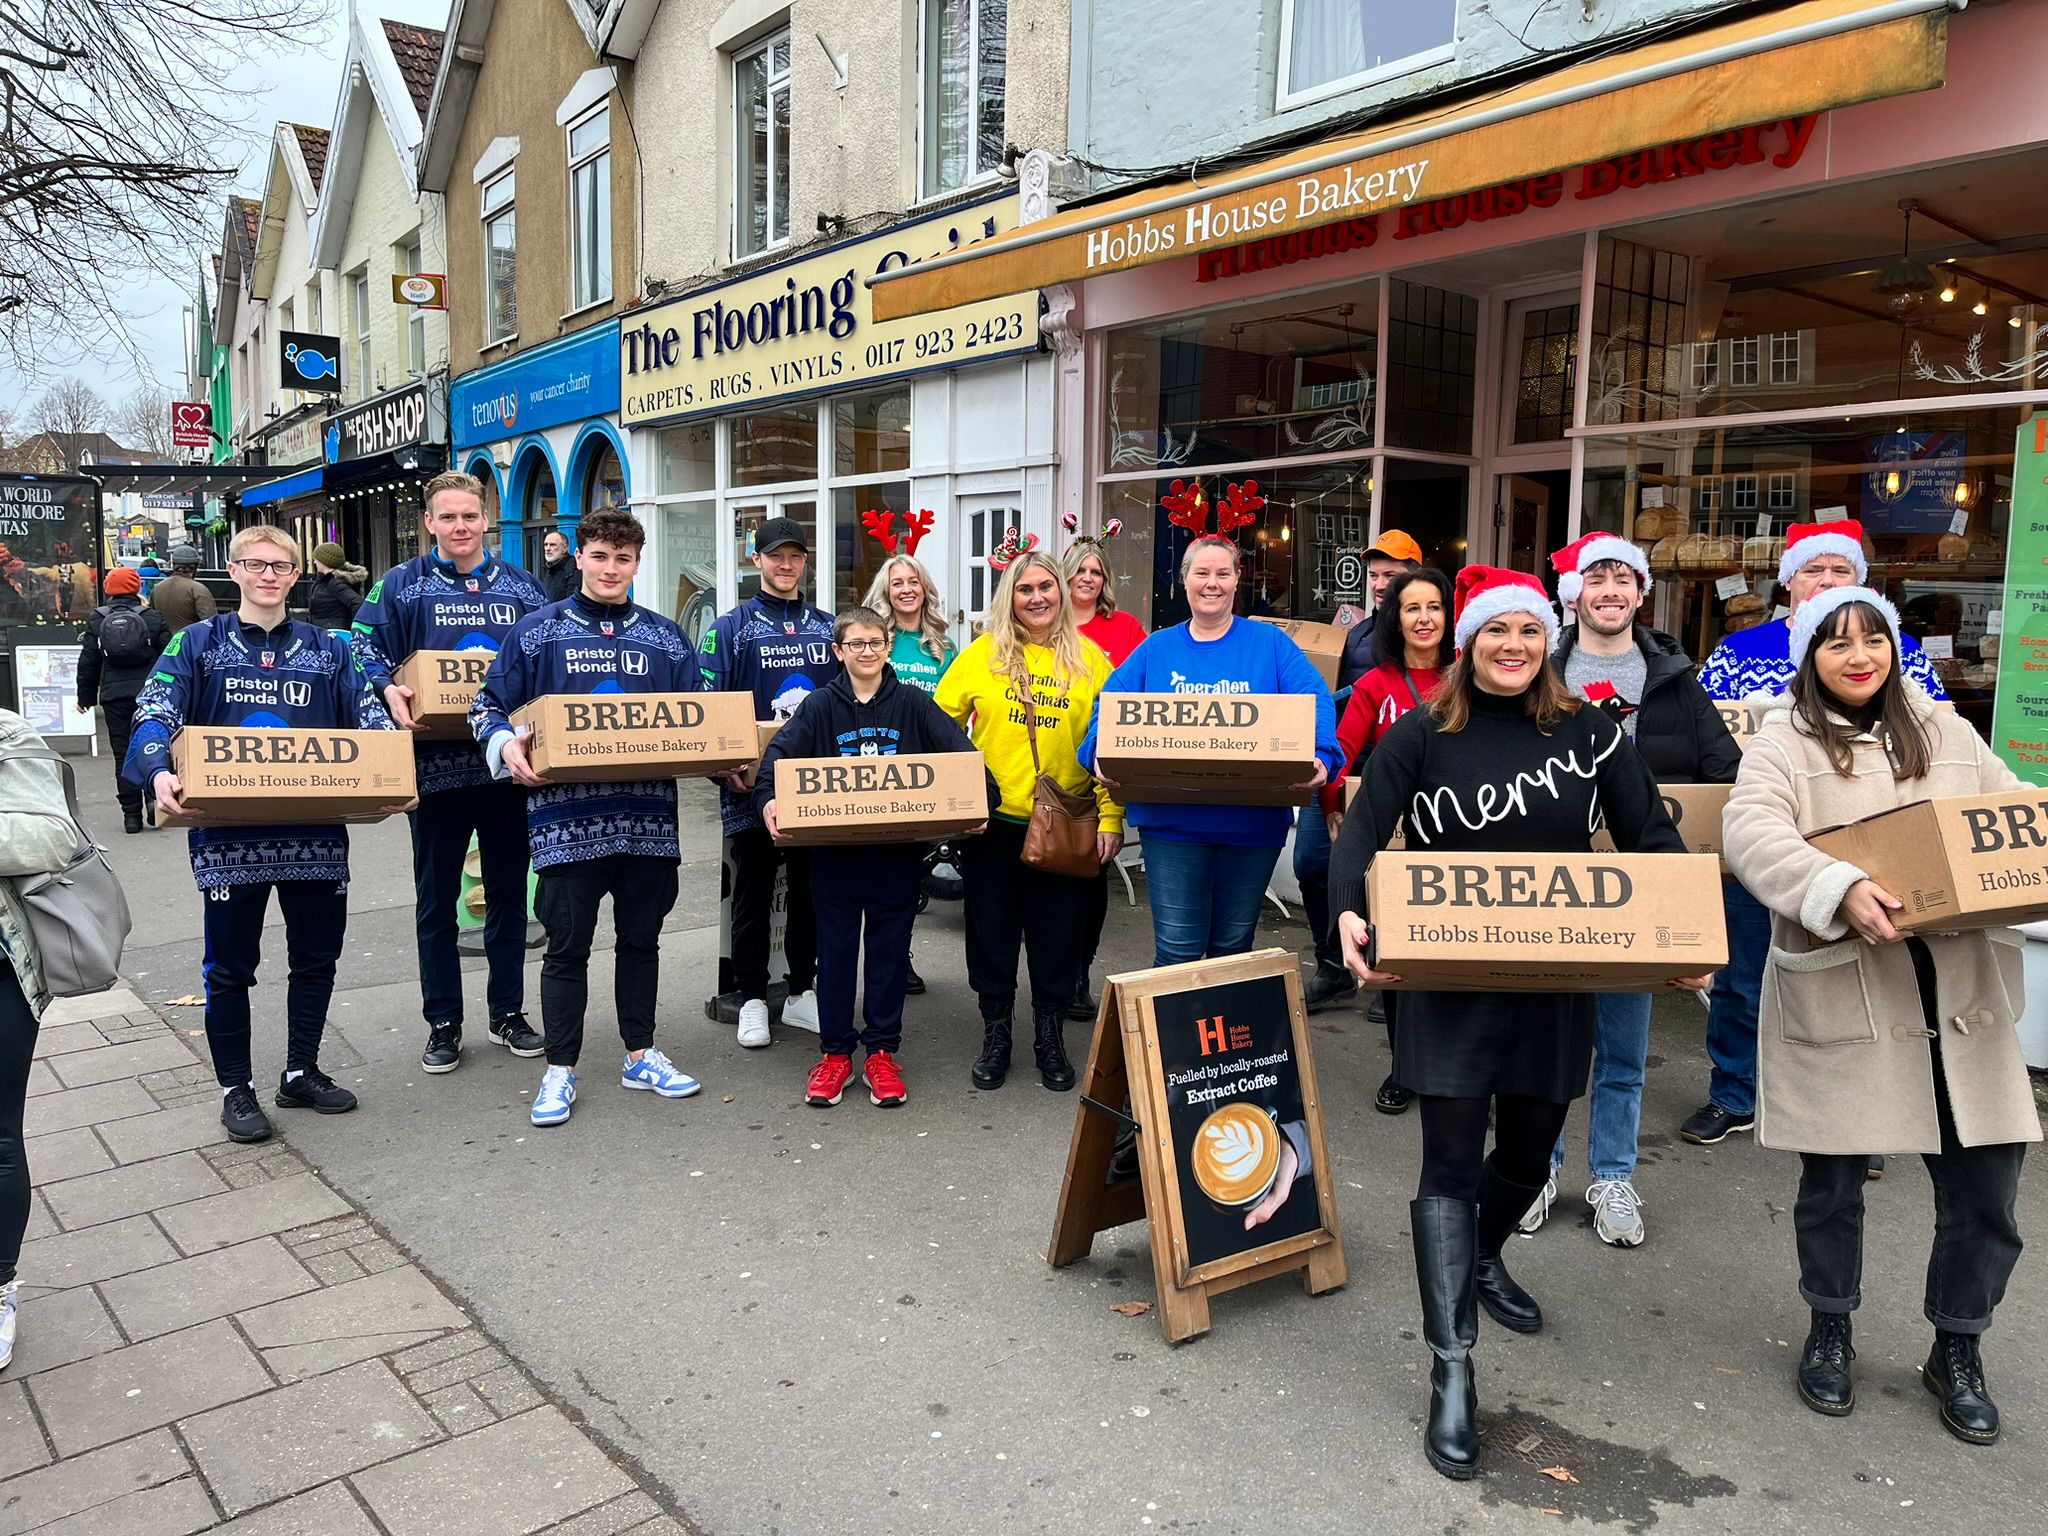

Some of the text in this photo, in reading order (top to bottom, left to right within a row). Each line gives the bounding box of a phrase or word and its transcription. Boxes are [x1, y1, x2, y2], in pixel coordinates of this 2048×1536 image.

[1574, 112, 1820, 200] Bakery
[1085, 159, 1430, 268] Hobbs House Bakery
[622, 268, 857, 375] The Flooring
[627, 312, 1024, 416] CARPETS RUGS VINYLS 0117 923 2423
[530, 370, 592, 410] your cancer charity
[472, 391, 517, 427] tenovus
[344, 420, 356, 438] THE
[355, 407, 383, 456] FISH
[384, 392, 425, 447] SHOP
[3, 487, 52, 503] WORLD
[22, 504, 65, 520] MORE
[1336, 546, 1363, 554] Certified
[434, 603, 484, 614] Bristol
[435, 615, 486, 626] Honda
[760, 643, 803, 657] Bristol
[436, 659, 492, 683] BR
[761, 656, 805, 669] Honda
[889, 662, 937, 675] peration
[225, 676, 278, 692] Bristol
[225, 691, 278, 705] Honda
[440, 693, 475, 704] Hobb
[564, 700, 705, 732] BREAD
[1116, 700, 1260, 727] BREAD
[203, 735, 360, 764] BREAD
[567, 741, 613, 755] Hobbs
[615, 741, 659, 754] House
[662, 739, 707, 753] Bakery
[1115, 736, 1159, 748] Hobbs
[1162, 737, 1206, 749] House
[1209, 737, 1258, 751] Bakery
[2008, 739, 2043, 750] Bread
[205, 774, 256, 787] Hobbs
[259, 774, 307, 787] House
[310, 774, 361, 789] Bakery
[795, 762, 935, 795] BREAD
[797, 804, 842, 818] Hobbs
[844, 803, 887, 816] House
[890, 801, 937, 815] Bakery
[1405, 864, 1634, 909] BREAD
[1978, 868, 2041, 891] Hobbs
[1407, 924, 1478, 943] Hobbs
[1483, 925, 1554, 943] House
[1558, 927, 1636, 949] Bakery
[1196, 1015, 1228, 1056] H
[1229, 1025, 1250, 1034] Hobbs
[1232, 1040, 1253, 1050] Bakery
[1168, 1050, 1289, 1087] Fuelled by locally-roasted
[1186, 1074, 1278, 1105] Extract Coffee
